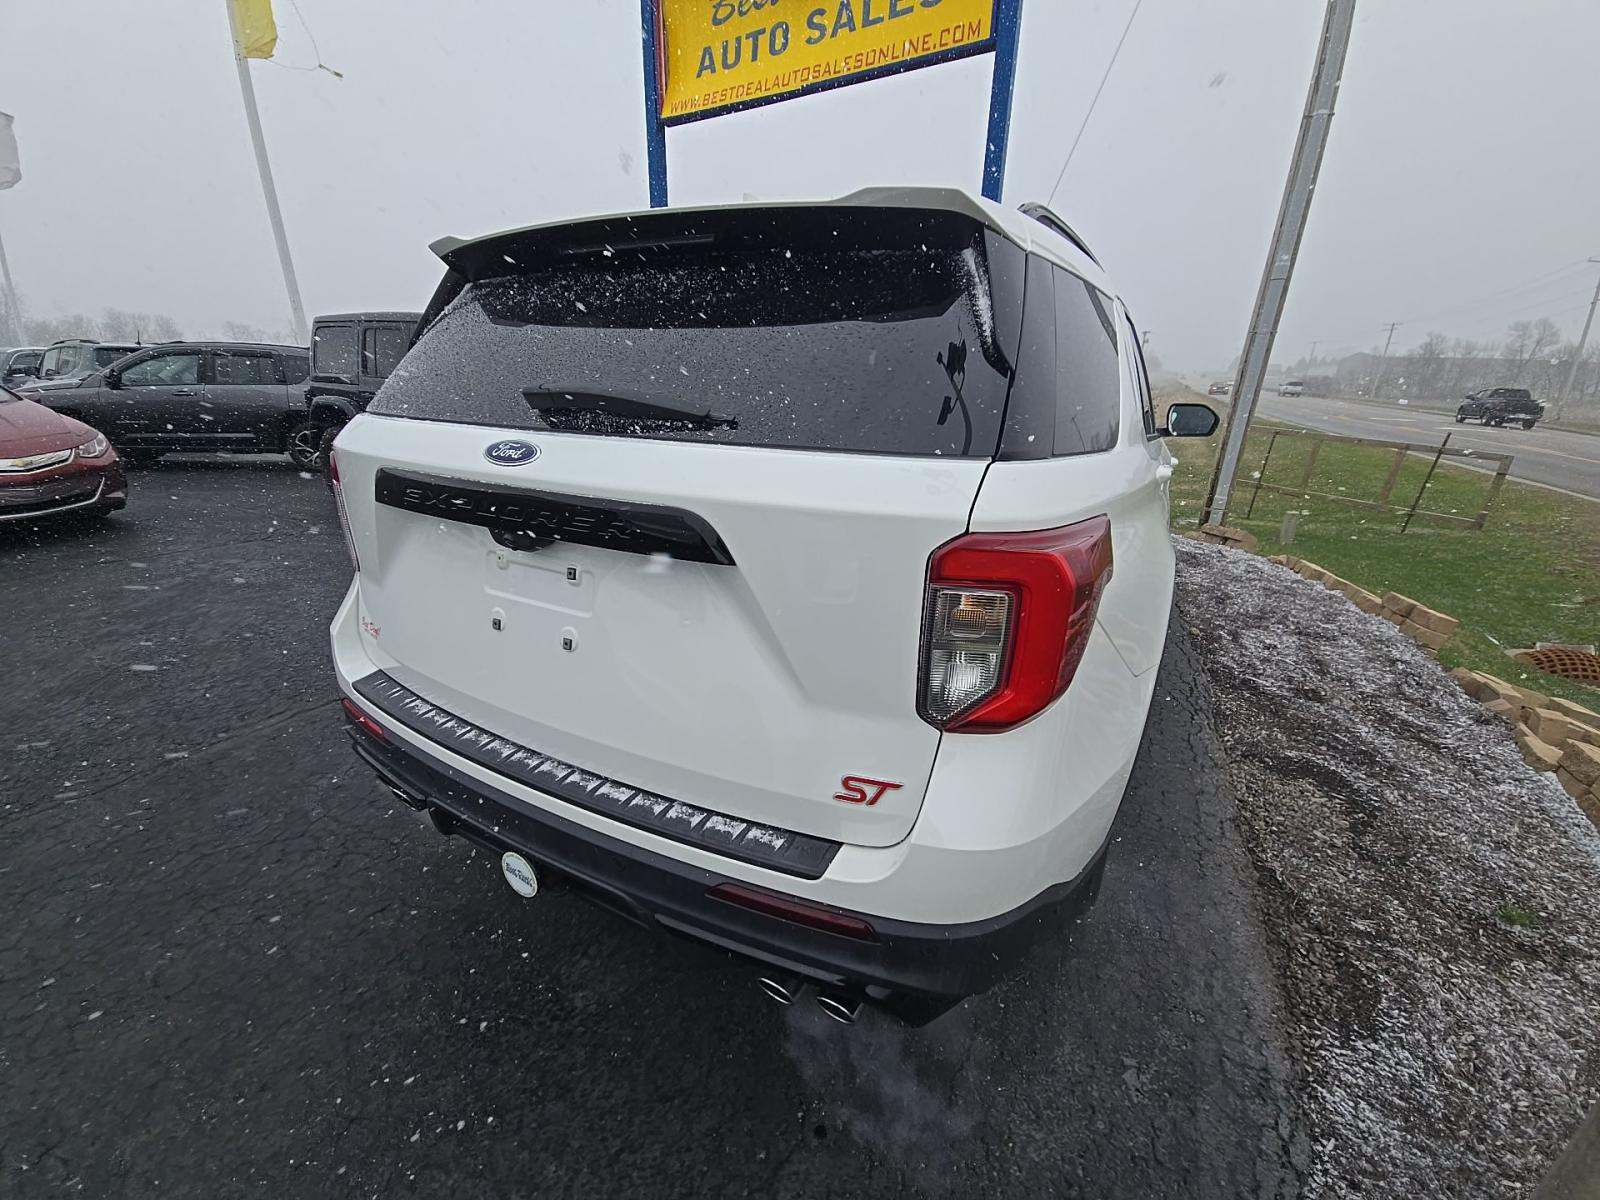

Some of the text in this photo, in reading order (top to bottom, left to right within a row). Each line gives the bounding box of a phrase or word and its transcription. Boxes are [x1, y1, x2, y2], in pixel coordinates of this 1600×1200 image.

[696, 0, 944, 78] AUTO SALE
[670, 19, 982, 114] WWW.BESTDEALAUTOSALESONLINE.COM
[492, 443, 526, 459] Ford
[833, 775, 904, 806] ST
